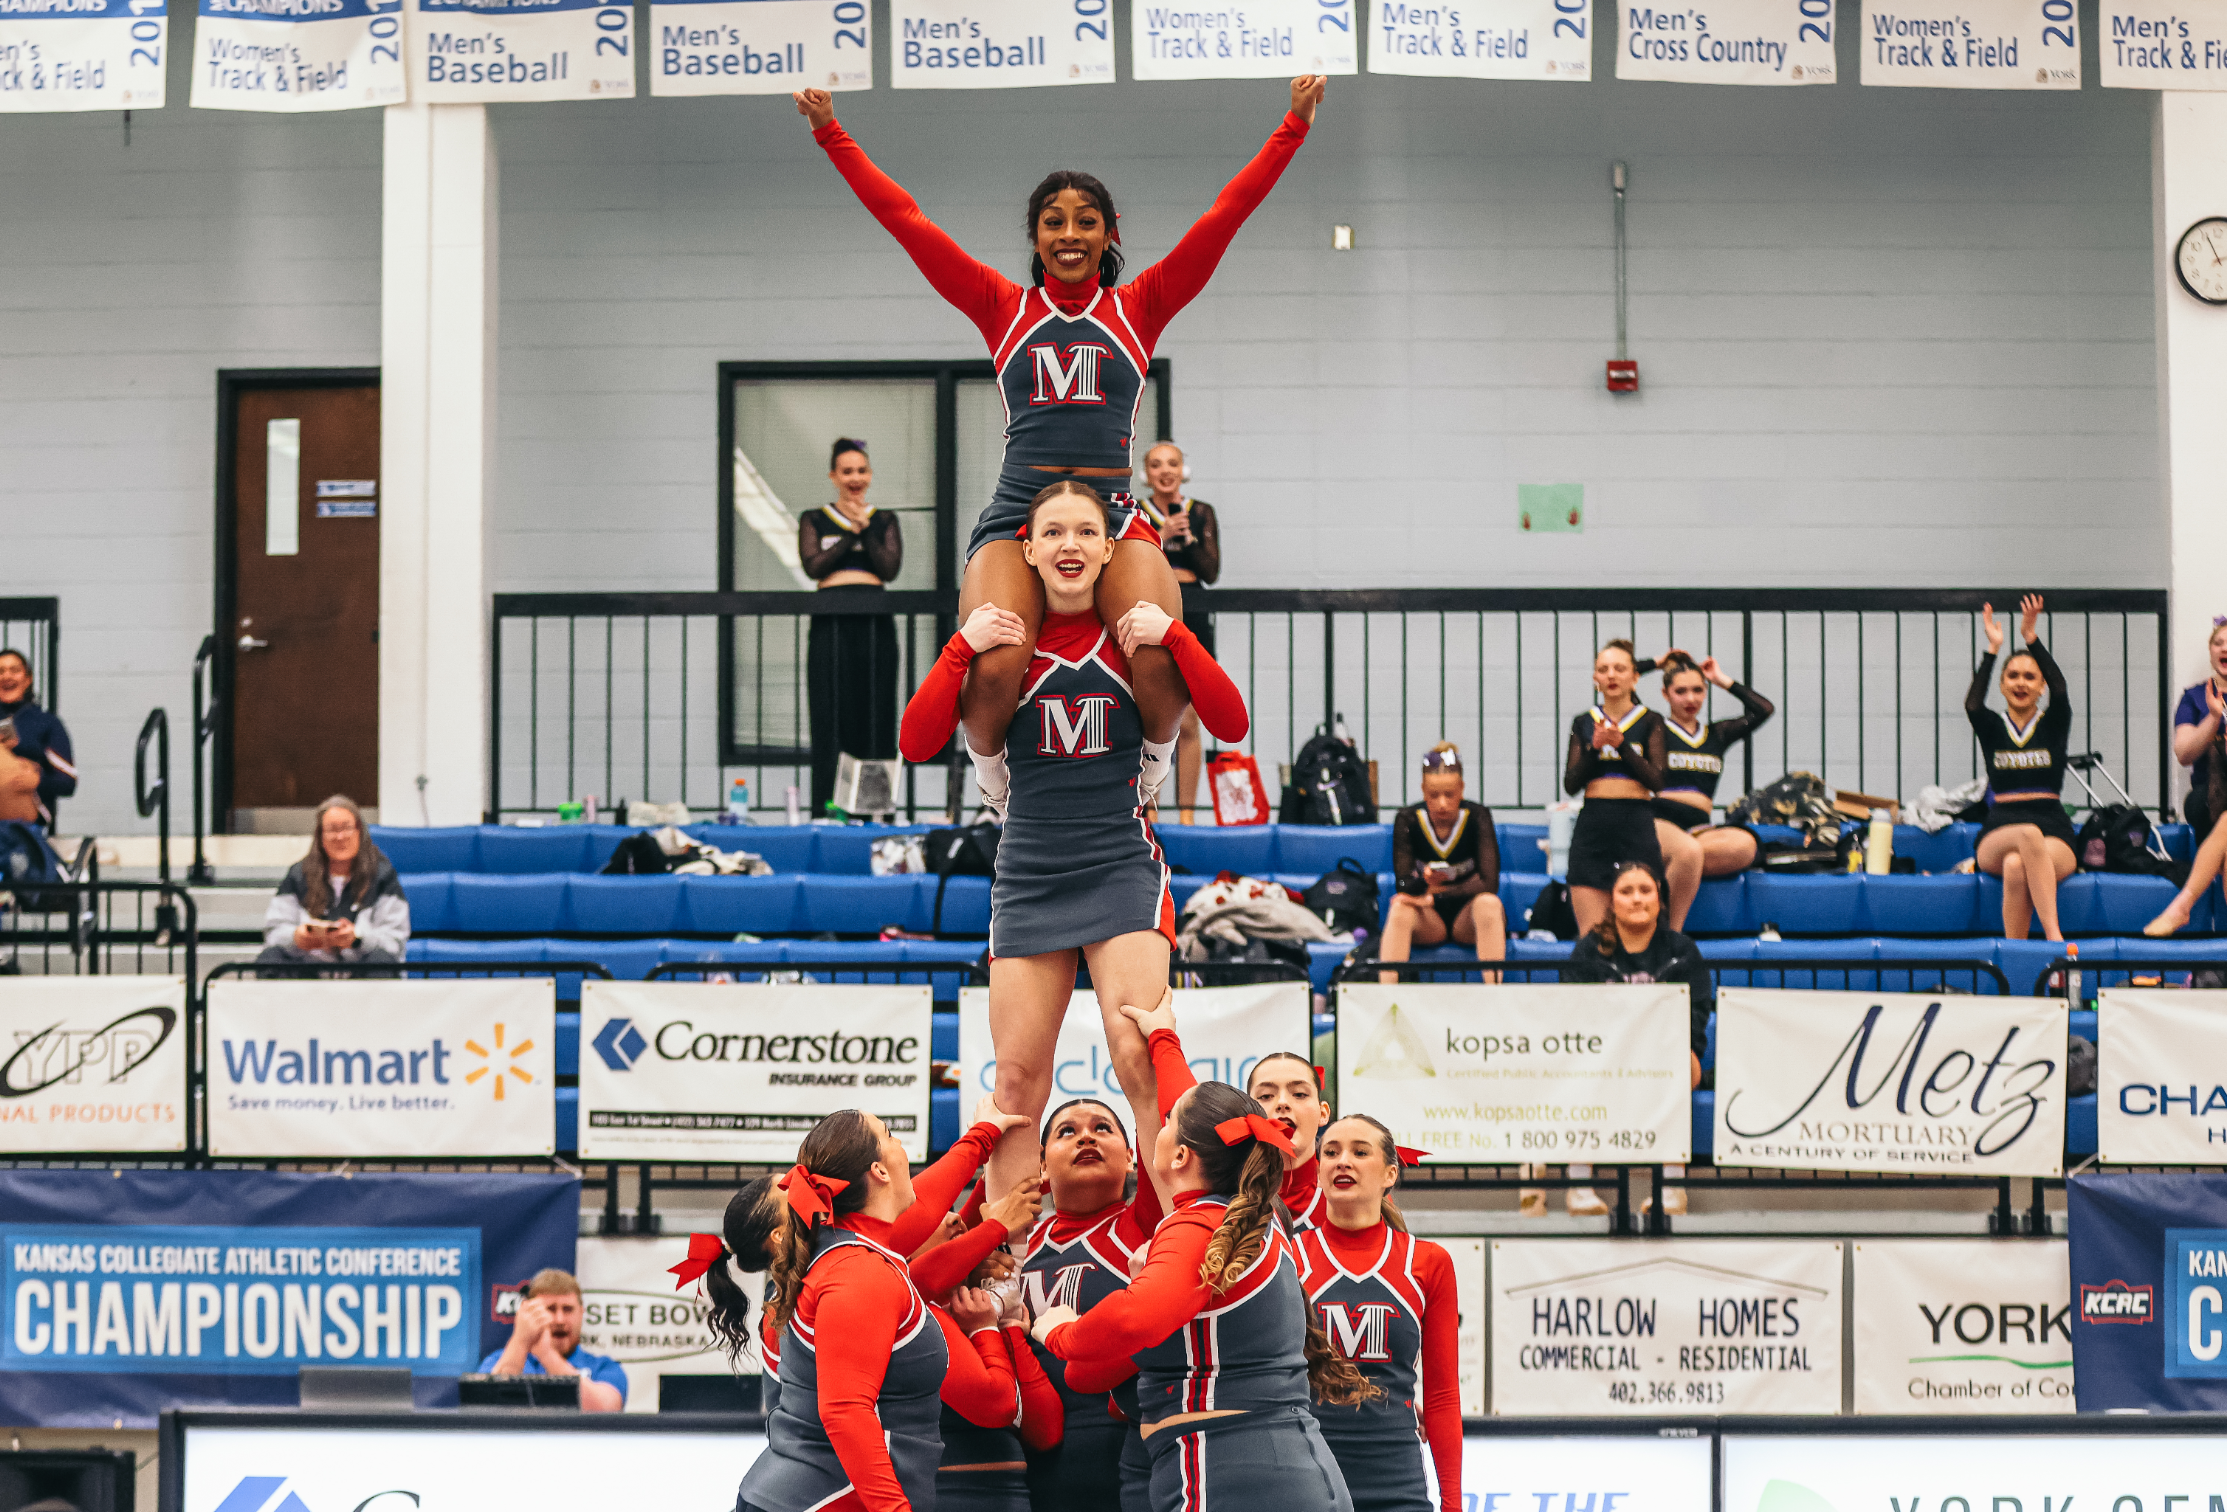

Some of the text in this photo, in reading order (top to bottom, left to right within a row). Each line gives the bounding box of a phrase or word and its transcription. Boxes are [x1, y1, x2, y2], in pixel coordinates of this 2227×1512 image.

[596, 0, 628, 57] 20
[903, 17, 981, 39] Men's
[1146, 8, 1245, 29] Women's
[1382, 3, 1461, 28] Men's
[1629, 7, 1707, 32] Men's
[1872, 14, 1971, 37] Women's
[2042, 0, 2075, 48] 20
[2112, 15, 2189, 37] Men's
[0, 40, 40, 61] n's
[428, 32, 505, 54] Men's
[662, 25, 740, 46] Men's
[1149, 27, 1293, 58] Track & Field
[1382, 25, 1528, 60] Track & Field
[209, 38, 299, 64] Women's
[663, 43, 804, 75] Baseball
[904, 36, 1046, 68] Baseball
[1629, 32, 1787, 72] Cross Country
[1874, 37, 2018, 67] Track & Field
[2112, 38, 2172, 69] Track
[2181, 40, 2196, 69] &
[31, 63, 46, 90] &
[55, 60, 105, 90] Field
[209, 61, 348, 93] Track & Field
[428, 52, 568, 83] Baseball
[655, 1021, 917, 1063] Cornerstone
[1446, 1028, 1603, 1061] kopsa otte
[222, 1038, 451, 1085] Walmart
[769, 1073, 917, 1087] INSURANCE GROUP
[1725, 1002, 2055, 1157] Metz
[50, 1103, 175, 1123] PRODUCTS
[228, 1094, 454, 1114] Save money. Live better.
[1423, 1102, 1607, 1124] www.kopsaotte.com
[2119, 1083, 2227, 1115] CHA
[1422, 1131, 1460, 1148] FREE
[1505, 1132, 1512, 1148] 1
[1522, 1130, 1558, 1149] 800
[1565, 1130, 1600, 1149] 975
[1609, 1130, 1656, 1149] 4829
[1800, 1121, 1975, 1146] MORTUARY
[1731, 1144, 1974, 1165] A CENTURY OF SERVICE
[14, 1244, 461, 1276] KANSAS COLLEGIATE ATHLETIC CONFERENCE
[14, 1279, 462, 1359] CHAMPIONSHIP
[1318, 1301, 1400, 1363] M
[1533, 1297, 1799, 1338] HARLOW HOMES
[1918, 1303, 2072, 1345] YORK
[613, 1334, 708, 1348] NEBRASKA
[1520, 1344, 1640, 1371] COMMERCIAL
[1679, 1345, 1812, 1372] RESIDENTIAL
[1609, 1382, 1725, 1405] 402.366.9813
[1908, 1377, 2075, 1400] Chamber of Co
